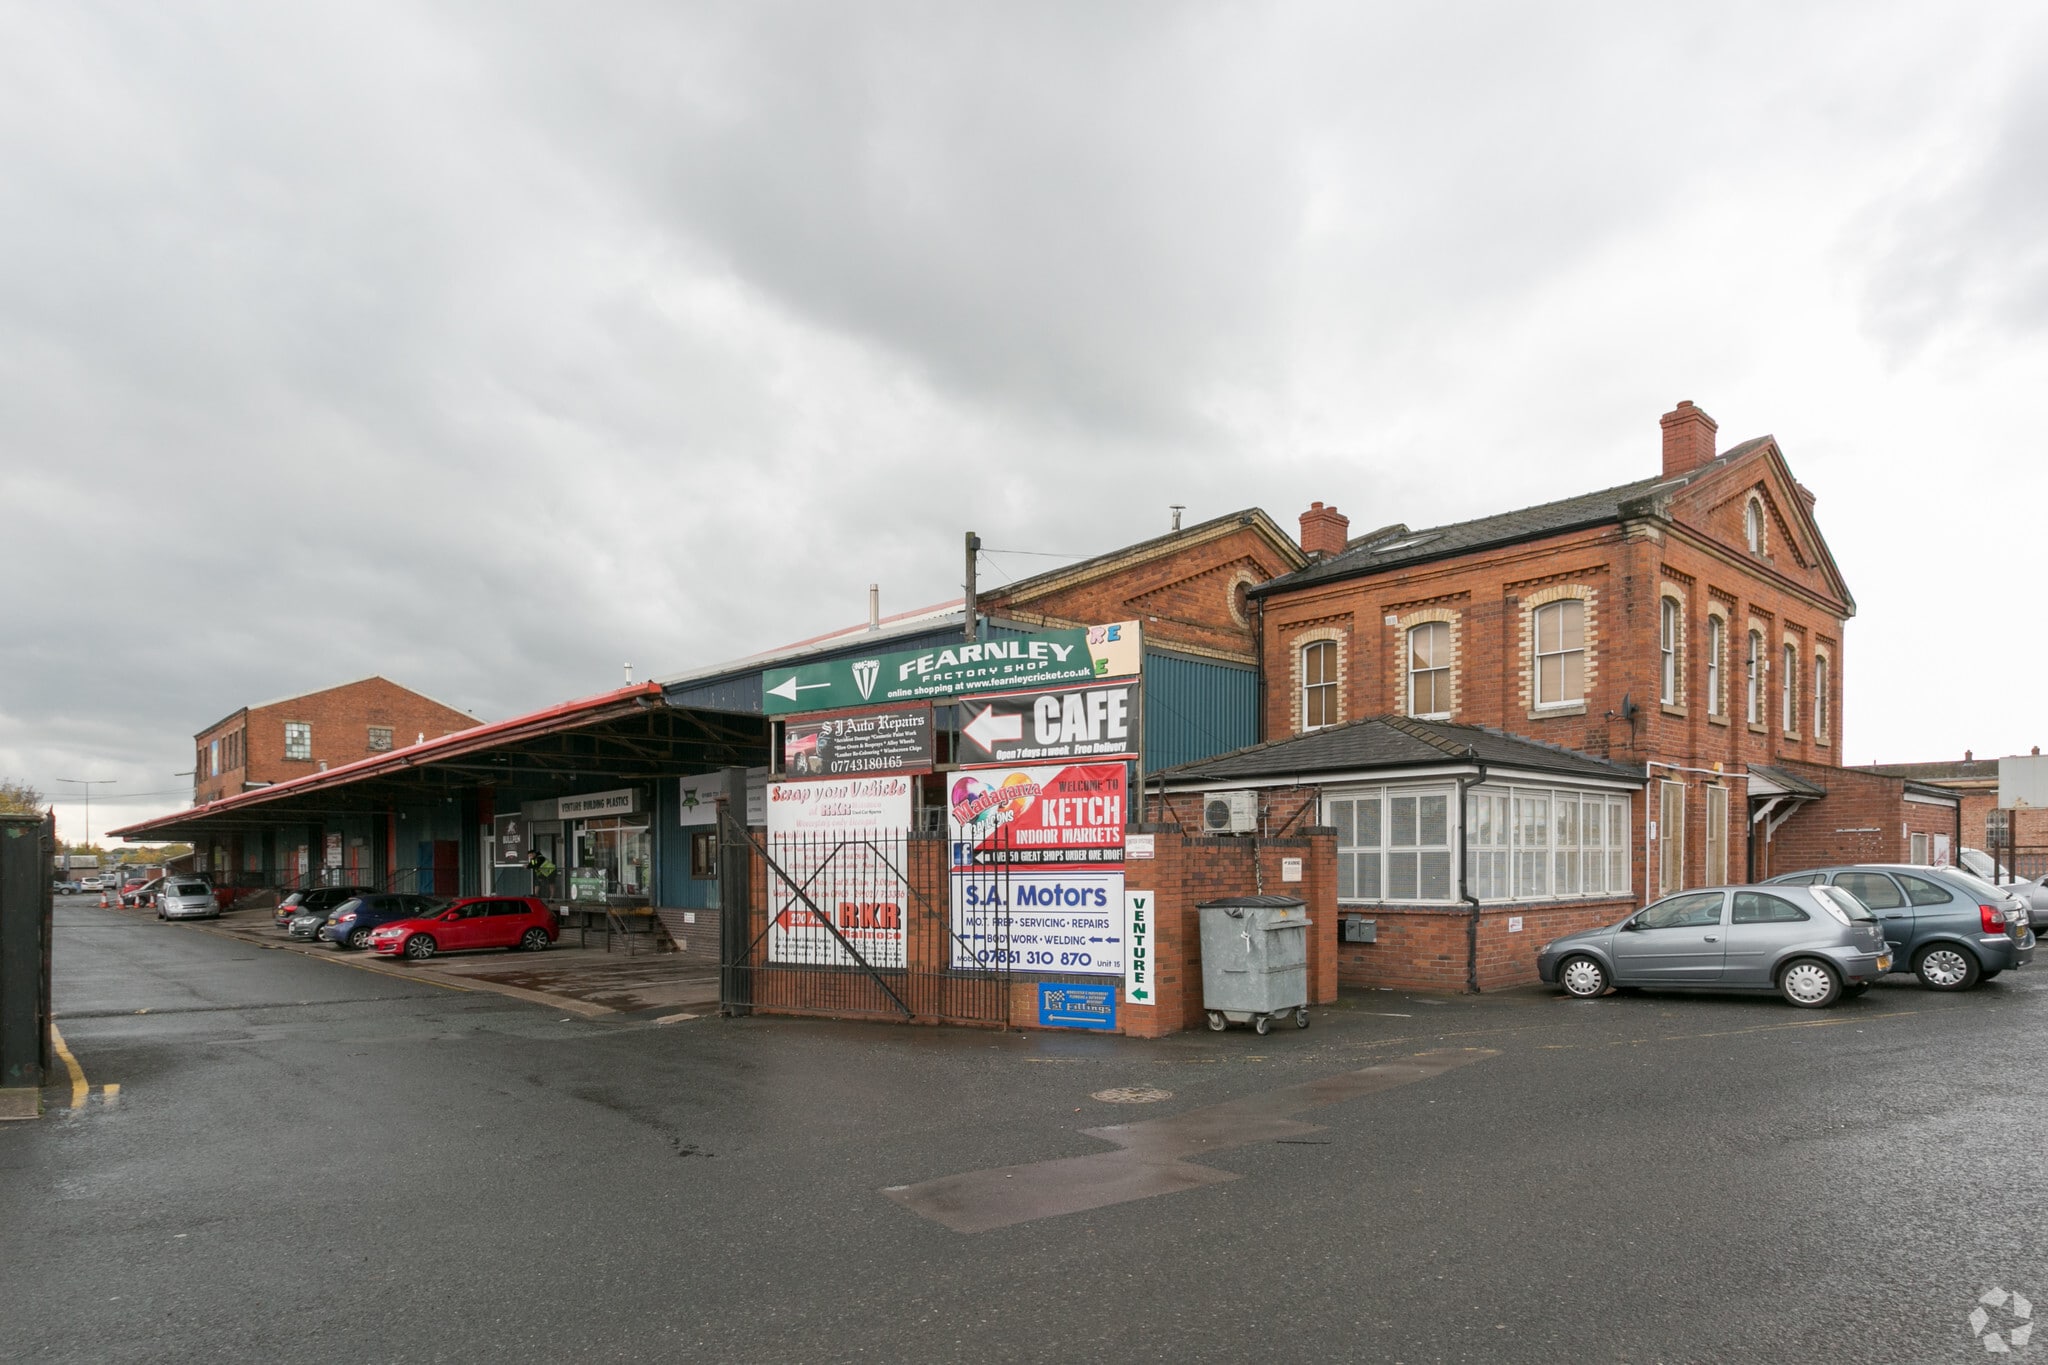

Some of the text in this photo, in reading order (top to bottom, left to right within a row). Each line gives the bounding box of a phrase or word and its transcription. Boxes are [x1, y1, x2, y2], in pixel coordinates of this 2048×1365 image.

[899, 641, 1074, 682] FEARNLEY
[922, 661, 1049, 682] FACTORY SHOP
[887, 667, 1091, 698] online shopping at www.fearnleycricket.co.uk
[844, 719, 874, 738] Auto
[878, 714, 925, 734] Repairs
[1034, 688, 1128, 745] CAFE
[996, 741, 1126, 760] Open 7 days a week Free Delivery
[831, 756, 902, 772] 07743180165
[772, 779, 906, 804] Scrap your Vehicle
[1059, 779, 1119, 793] WELCOME TO
[562, 796, 628, 812] VENTURE BUILDING PLASTICS
[821, 803, 852, 816] RKR
[952, 783, 1043, 826] Madaganza
[1042, 796, 1120, 827] KETCH
[1016, 827, 1120, 844] INDOOR MARKETS
[1009, 850, 1019, 862] 50
[1021, 851, 1041, 862] GREAT
[1043, 850, 1064, 861] SHOPS
[1065, 850, 1088, 861] UNDER
[1089, 850, 1102, 860] ONE
[1103, 848, 1123, 860] ROOF!
[966, 883, 1107, 907] S.A. Motors
[791, 914, 806, 924] 200
[840, 902, 901, 929] RKR
[966, 917, 1109, 928] MO.T. PREP SERVICING REPAIRS
[1045, 935, 1086, 945] WELDING
[1133, 898, 1146, 983] VENTURE
[977, 950, 1020, 964] 07861
[1026, 951, 1053, 965] 310
[1060, 952, 1092, 966] 870
[1066, 1003, 1111, 1013] Fittings
